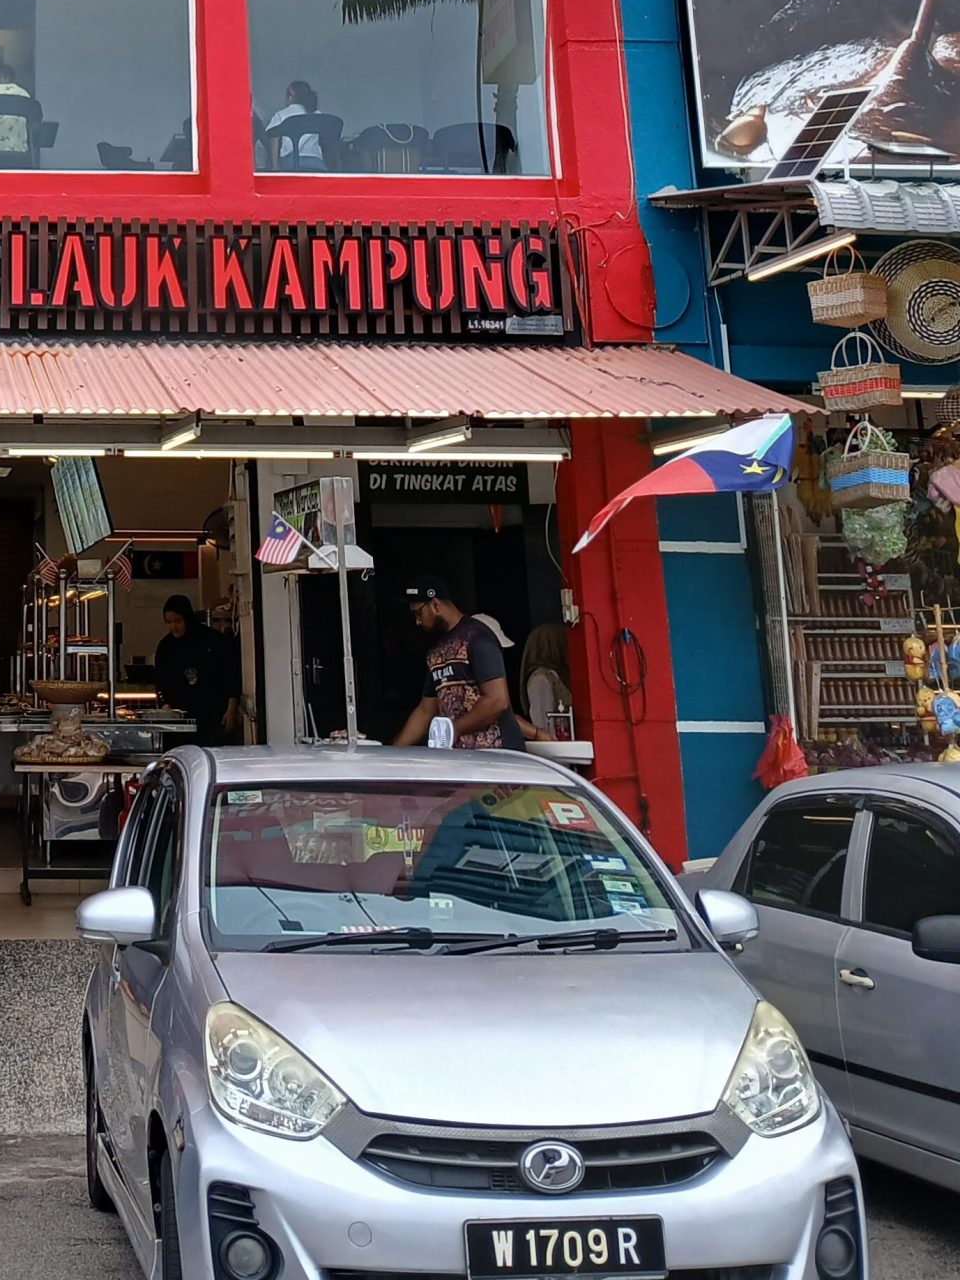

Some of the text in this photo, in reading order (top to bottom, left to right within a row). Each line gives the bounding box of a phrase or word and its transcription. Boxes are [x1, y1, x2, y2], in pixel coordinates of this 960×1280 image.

[7, 229, 190, 311] LAUK
[208, 233, 556, 316] KAMPUNG
[369, 473, 517, 492] DI TINGKAT ATAS
[547, 801, 586, 825] P
[492, 1227, 641, 1268] W 1709 R
